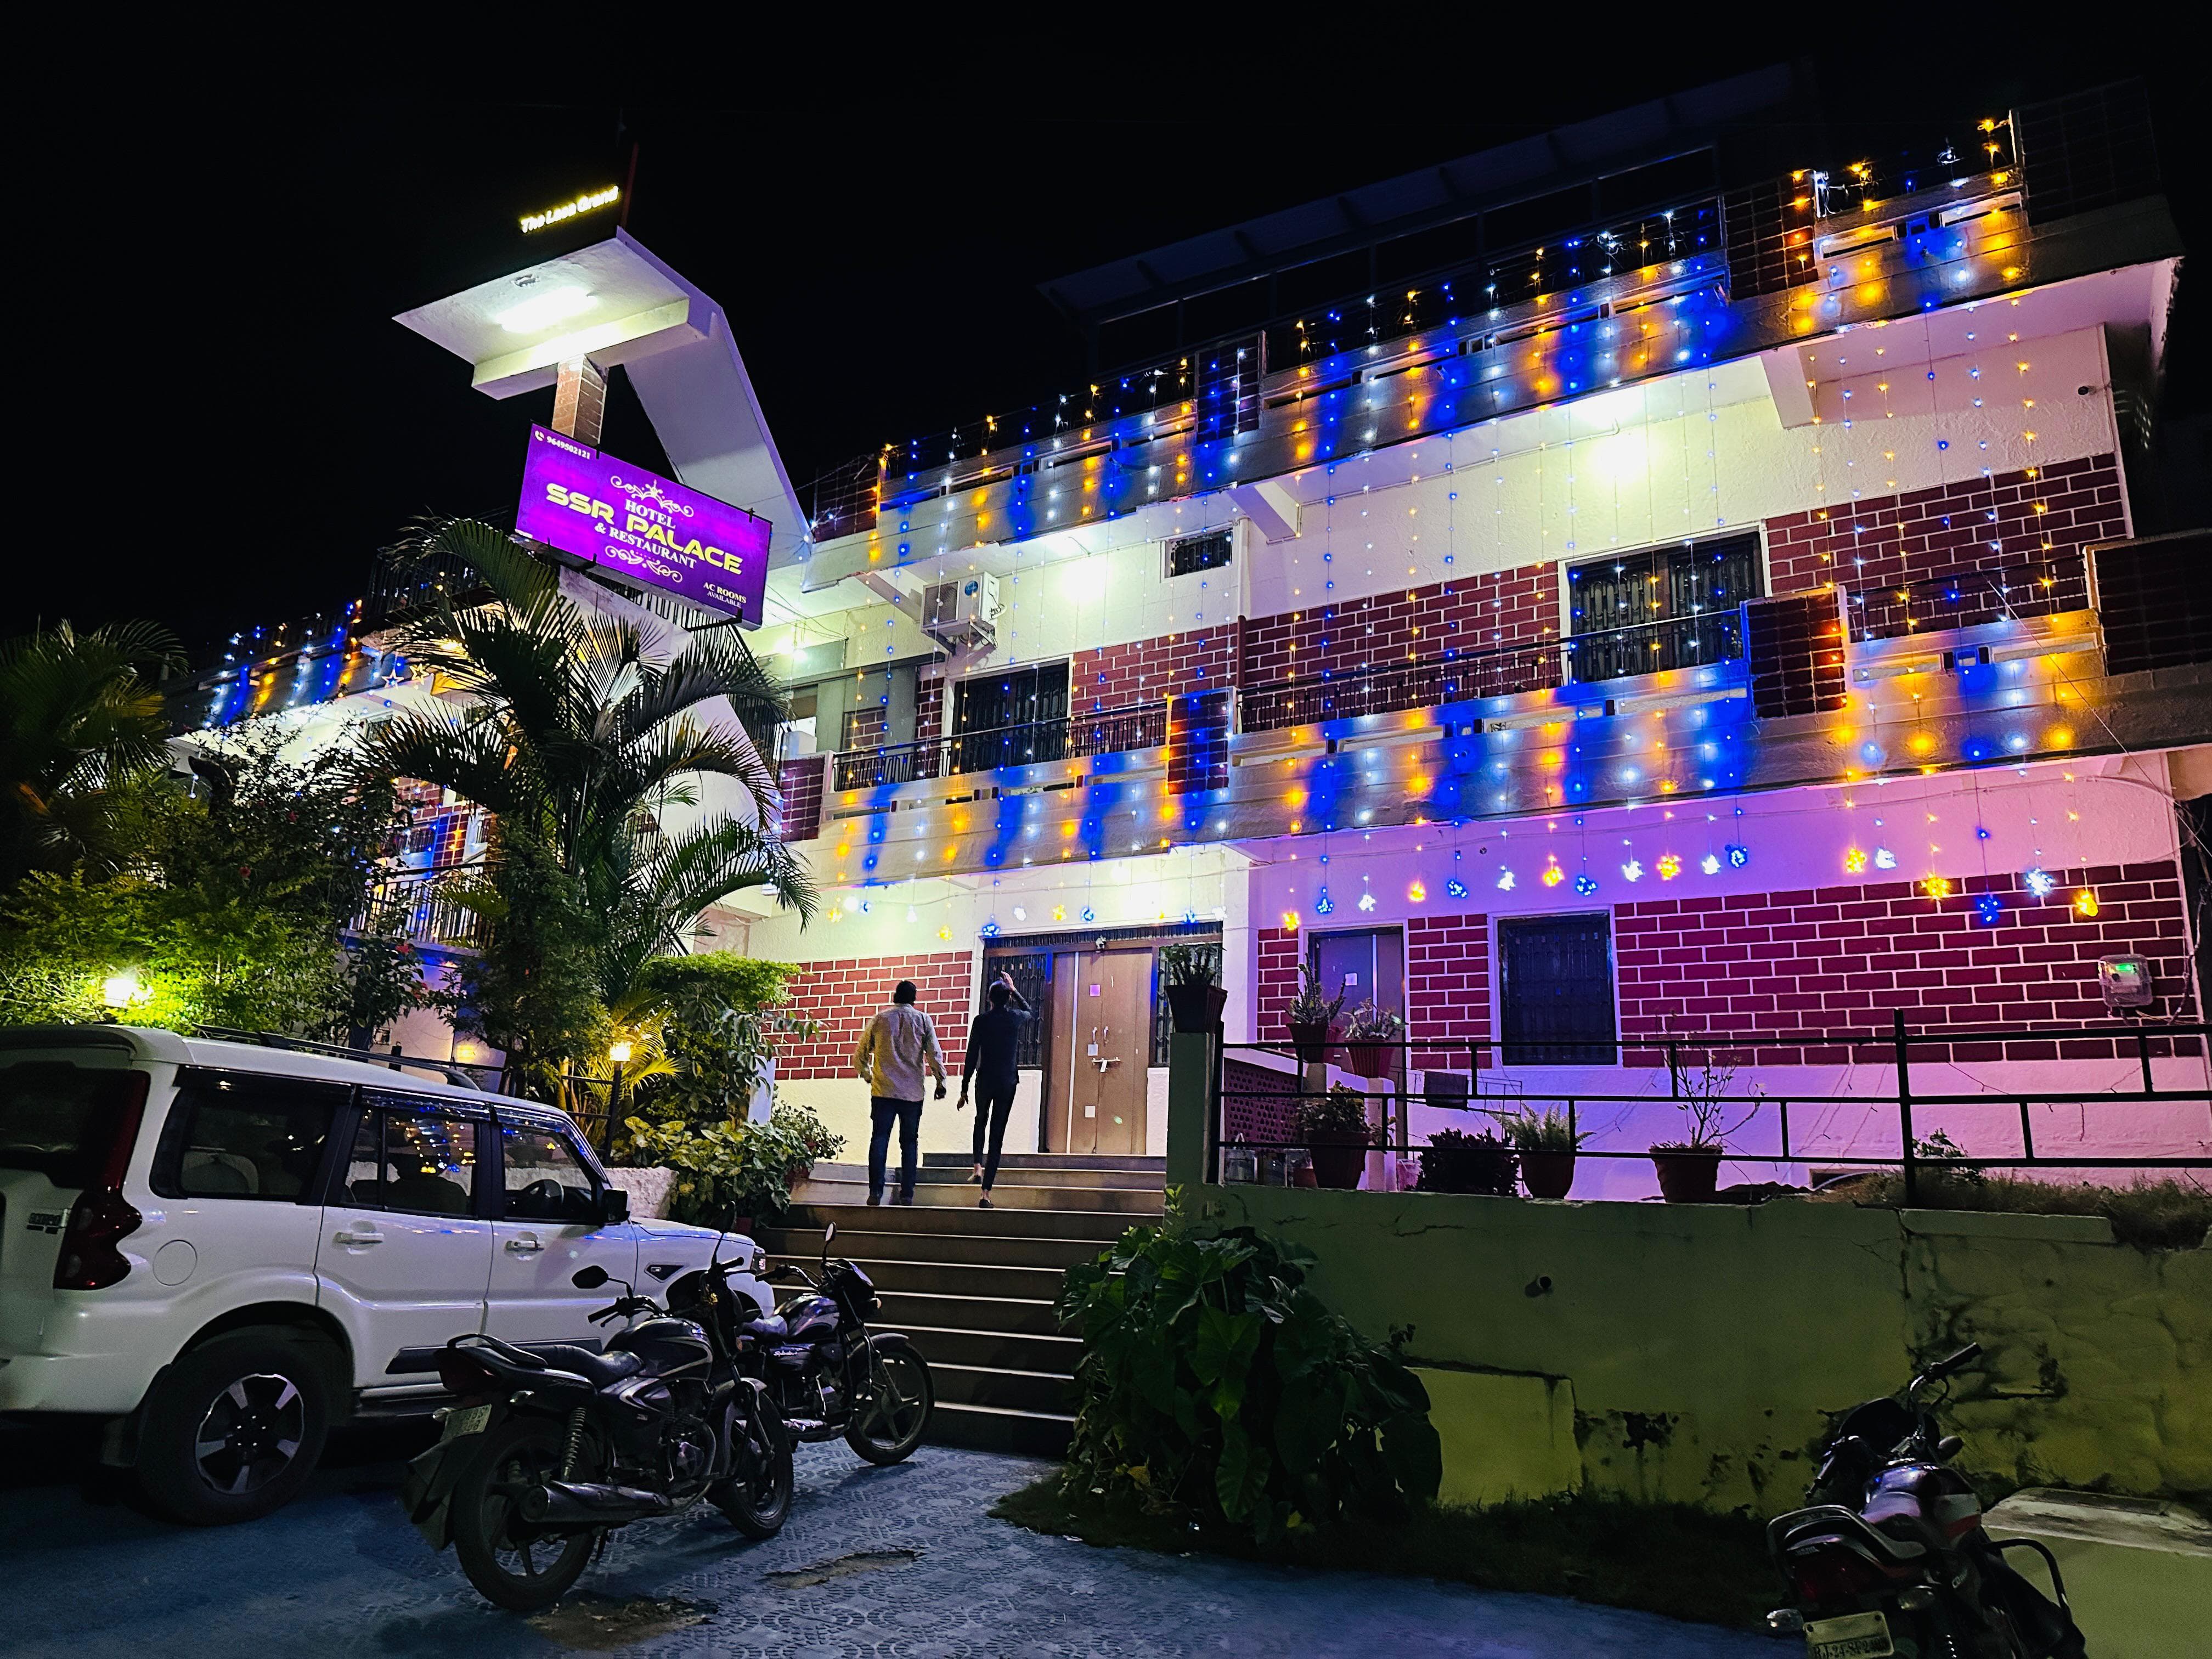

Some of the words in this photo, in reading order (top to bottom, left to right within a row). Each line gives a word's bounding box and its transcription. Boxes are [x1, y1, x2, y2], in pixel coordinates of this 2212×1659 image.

[546, 483, 614, 525] SSR
[627, 514, 743, 575] PALACE
[625, 499, 676, 529] HOTEL
[594, 522, 606, 534] &
[609, 526, 697, 569] RESTAURANT
[703, 582, 716, 591] AC
[716, 586, 747, 604] ROOMS
[707, 591, 742, 608] AVAILABLE
